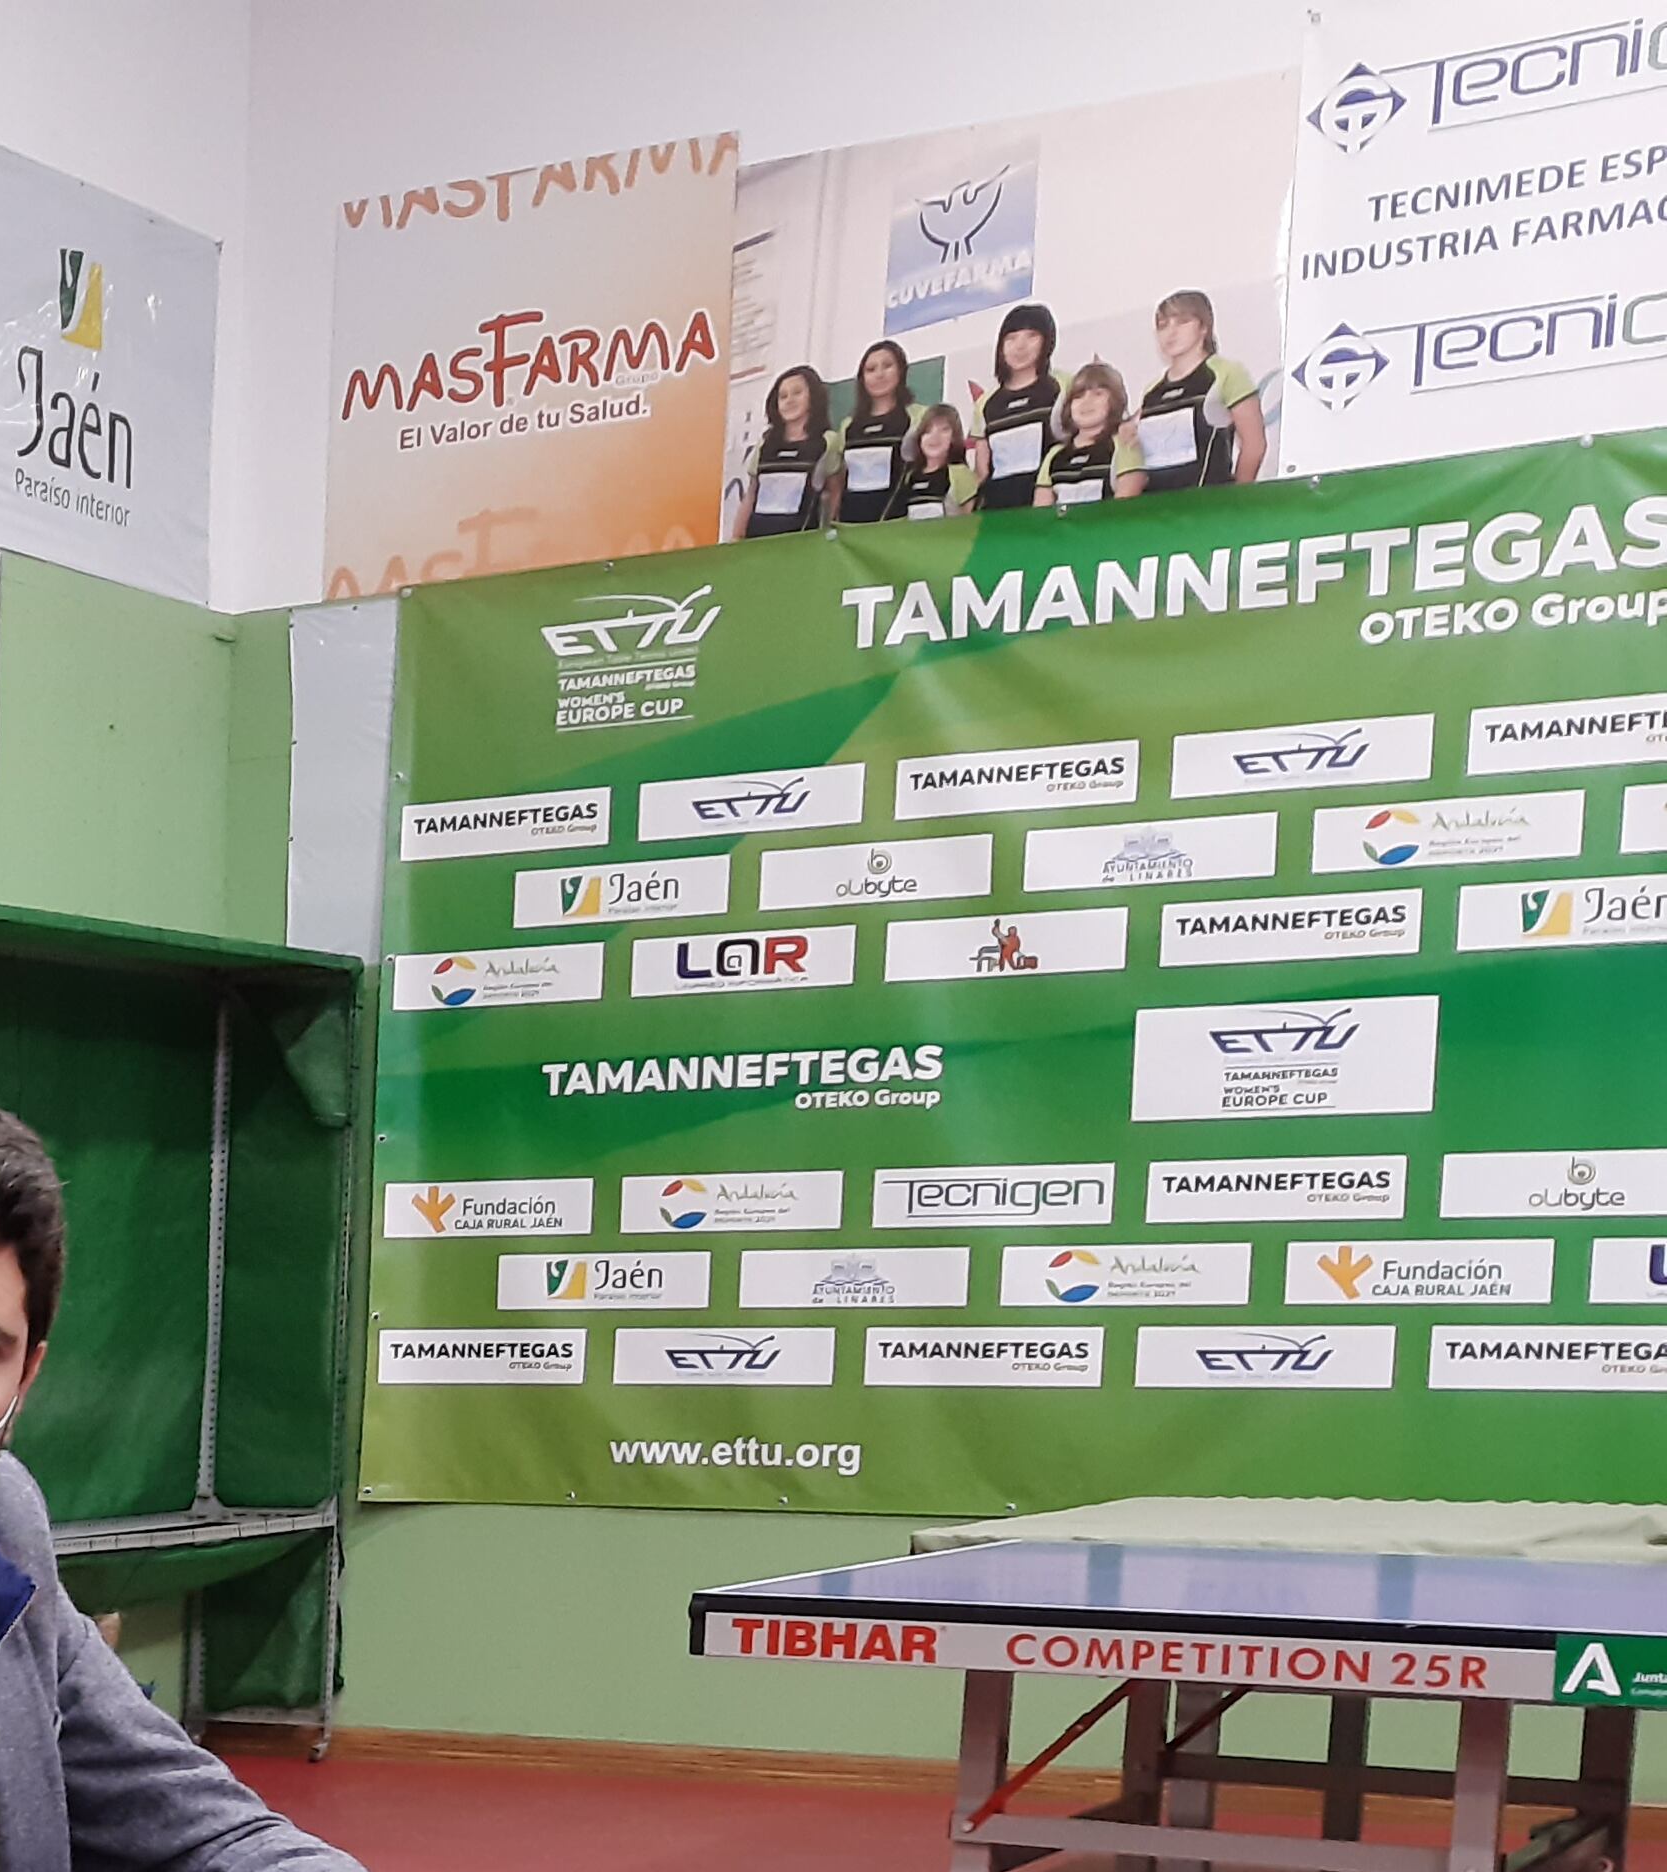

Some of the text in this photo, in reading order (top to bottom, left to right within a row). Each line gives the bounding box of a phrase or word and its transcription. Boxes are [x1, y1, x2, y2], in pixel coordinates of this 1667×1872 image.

[1368, 159, 1587, 222] TECNIMEDE
[1301, 225, 1499, 281] INDUSTRIA
[17, 346, 133, 489] Jaén
[399, 394, 647, 451] El Valor de tu Salud.
[15, 468, 131, 527] Paraíso interior
[841, 495, 1667, 649] TAMANNEFTEGAS
[1359, 589, 1667, 646] OTEKO Group
[557, 664, 696, 692] TAMANNEFTEGAS
[556, 698, 684, 726] EUROPE CUP
[557, 691, 626, 709] WOMEN'S
[1485, 710, 1667, 744] TAMANNEFT
[910, 757, 1125, 792] TAMANNEFTEGAS
[414, 803, 599, 836] TAMANNEFTEGAS
[608, 870, 680, 903] Jaén
[1176, 904, 1407, 937] TAMANNEFTEGAS
[542, 1044, 944, 1097] TAMANNEFTEGAS
[1223, 1067, 1339, 1082] TAMANNEFTEGAS
[794, 1087, 942, 1110] OTEKO Group
[1221, 1092, 1328, 1108] EUROPE CUP
[1162, 1169, 1391, 1194] TAMANNEFTEGAS
[454, 1215, 563, 1231] CAJA RURAL JAÉN
[461, 1196, 556, 1217] Fundación
[594, 1258, 664, 1290] Jaén
[1383, 1257, 1503, 1281] Fundación
[1371, 1280, 1511, 1297] CAJA RURAL JAÉN
[390, 1342, 573, 1360] TAMANNEFTEGAS
[878, 1341, 1089, 1360] TAMANNEFTEGAS
[609, 1437, 862, 1476] www.ettu.org
[732, 1617, 937, 1664] TIBHAR
[1006, 1632, 1488, 1689] COMPETITION 25R
